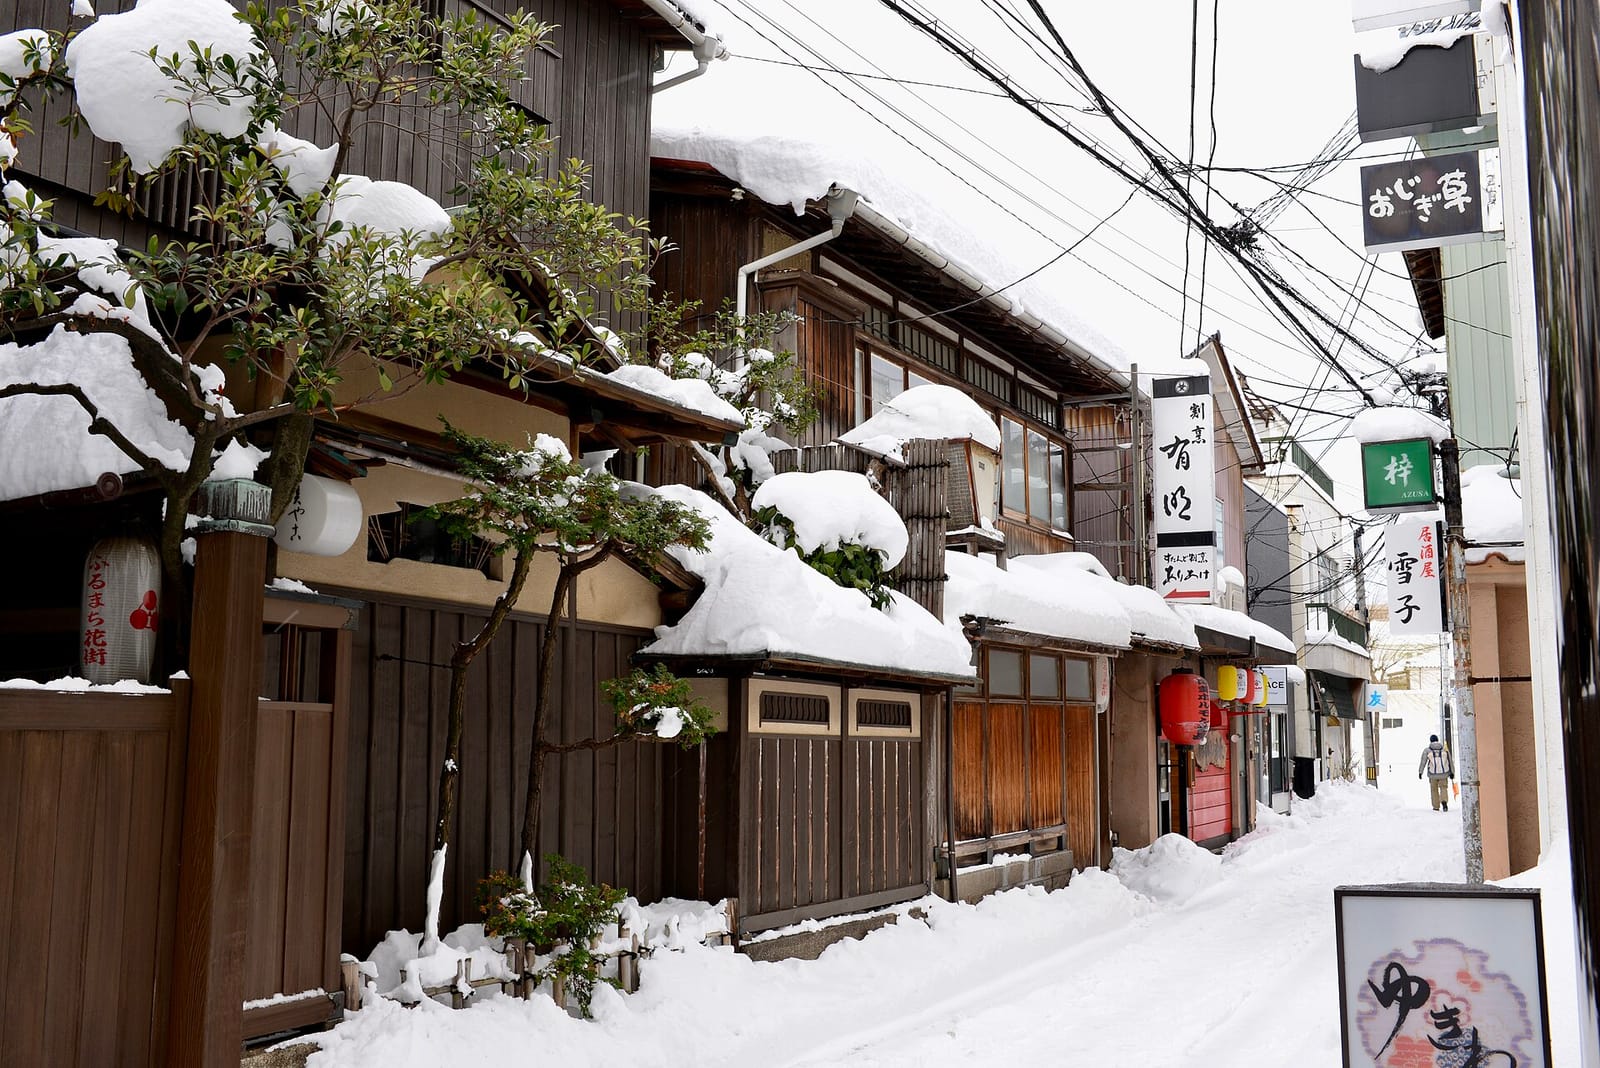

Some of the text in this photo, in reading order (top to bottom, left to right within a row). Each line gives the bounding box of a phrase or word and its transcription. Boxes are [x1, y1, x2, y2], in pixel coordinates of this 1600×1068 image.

[1368, 168, 1473, 223] おじぎ草
[1189, 402, 1206, 444] 割烹
[1383, 453, 1413, 488] 梓
[1401, 489, 1429, 499] AZUSA
[1417, 526, 1436, 578] 居酒屋
[1162, 565, 1210, 586] ありあけ
[1388, 552, 1421, 624] 雪子
[83, 555, 110, 666] ふるまち花街
[1367, 690, 1385, 707] 友
